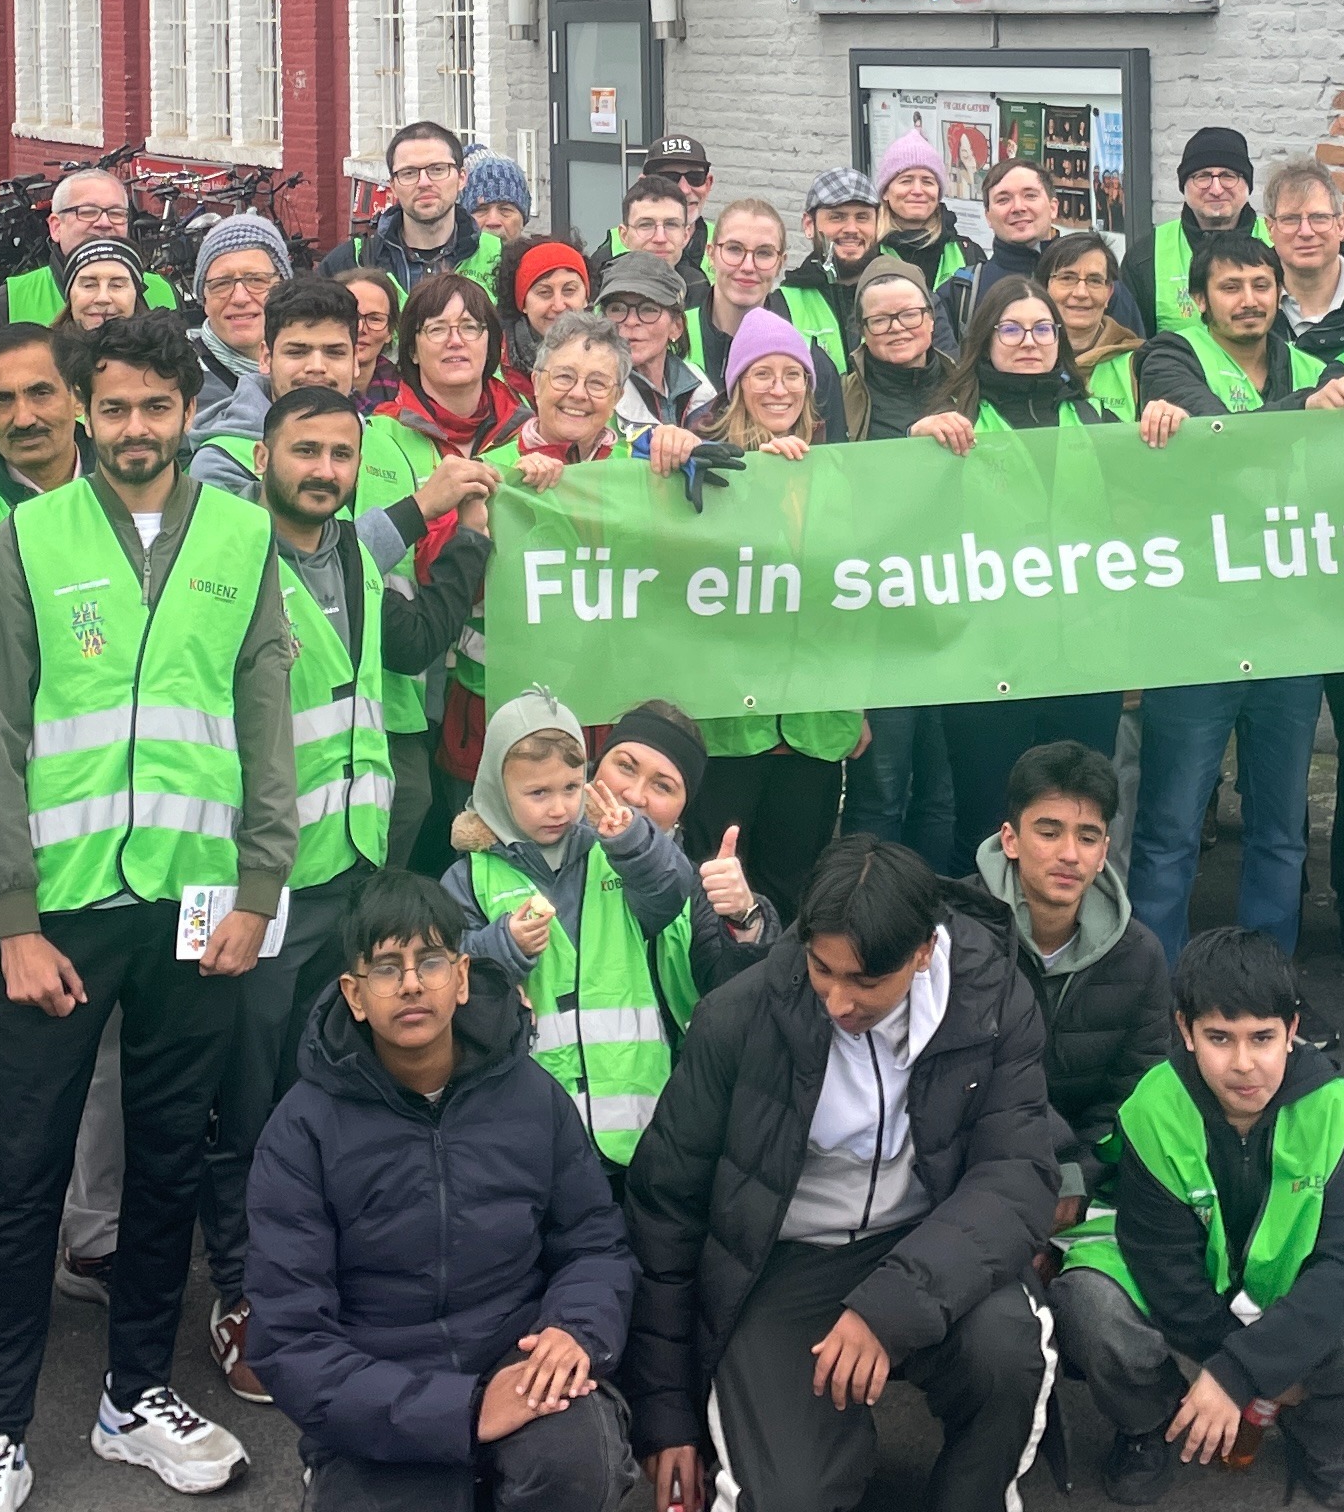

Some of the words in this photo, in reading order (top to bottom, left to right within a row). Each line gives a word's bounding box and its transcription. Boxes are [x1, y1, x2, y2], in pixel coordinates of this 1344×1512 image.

[662, 138, 691, 152] 1516
[189, 577, 239, 600] KOBLENZ
[522, 545, 660, 625] Für
[685, 545, 802, 617] ein
[830, 531, 1187, 611] sauberes
